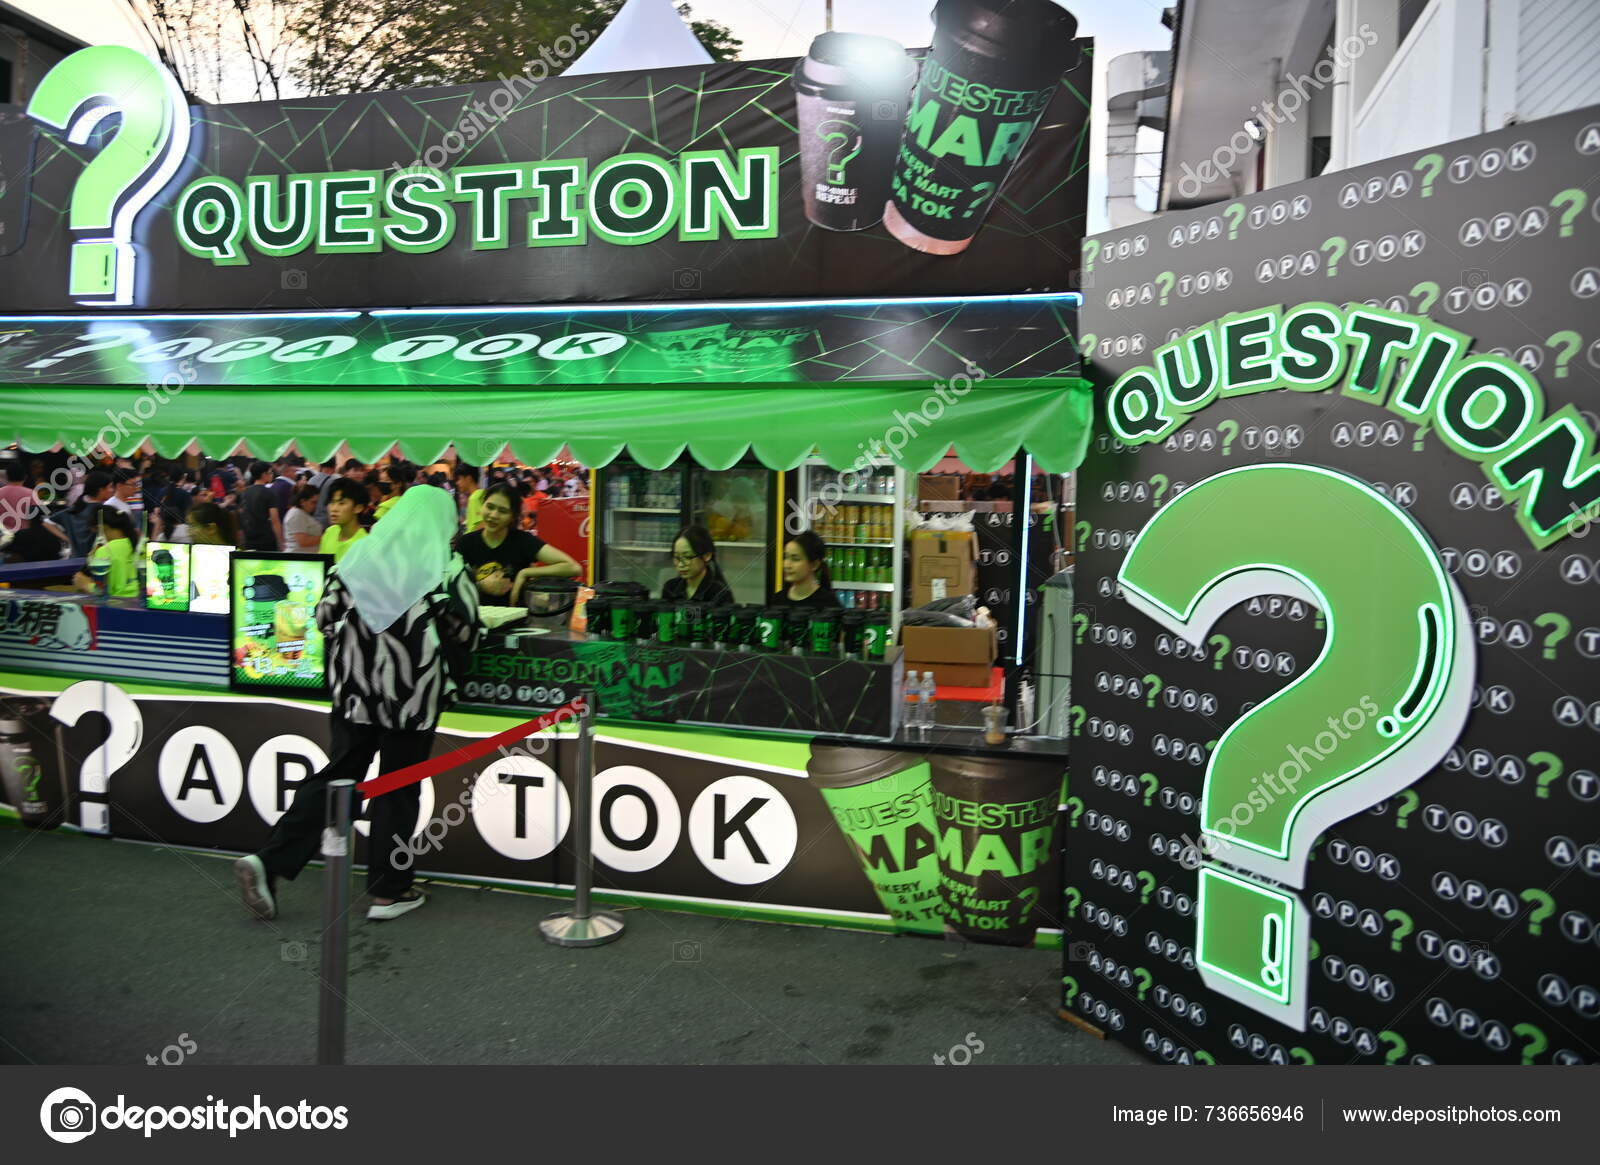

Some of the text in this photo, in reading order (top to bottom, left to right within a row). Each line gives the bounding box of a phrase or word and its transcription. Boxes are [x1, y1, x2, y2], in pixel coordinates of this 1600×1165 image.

[914, 176, 963, 199] MART
[179, 152, 775, 261] QUESTION
[911, 194, 956, 219] TOK
[132, 337, 352, 362] APA
[383, 333, 622, 361] TOK
[1108, 307, 1600, 540] QUESTION
[486, 765, 784, 876] TOK
[963, 897, 1011, 911] MART
[965, 913, 1009, 930] TOK
